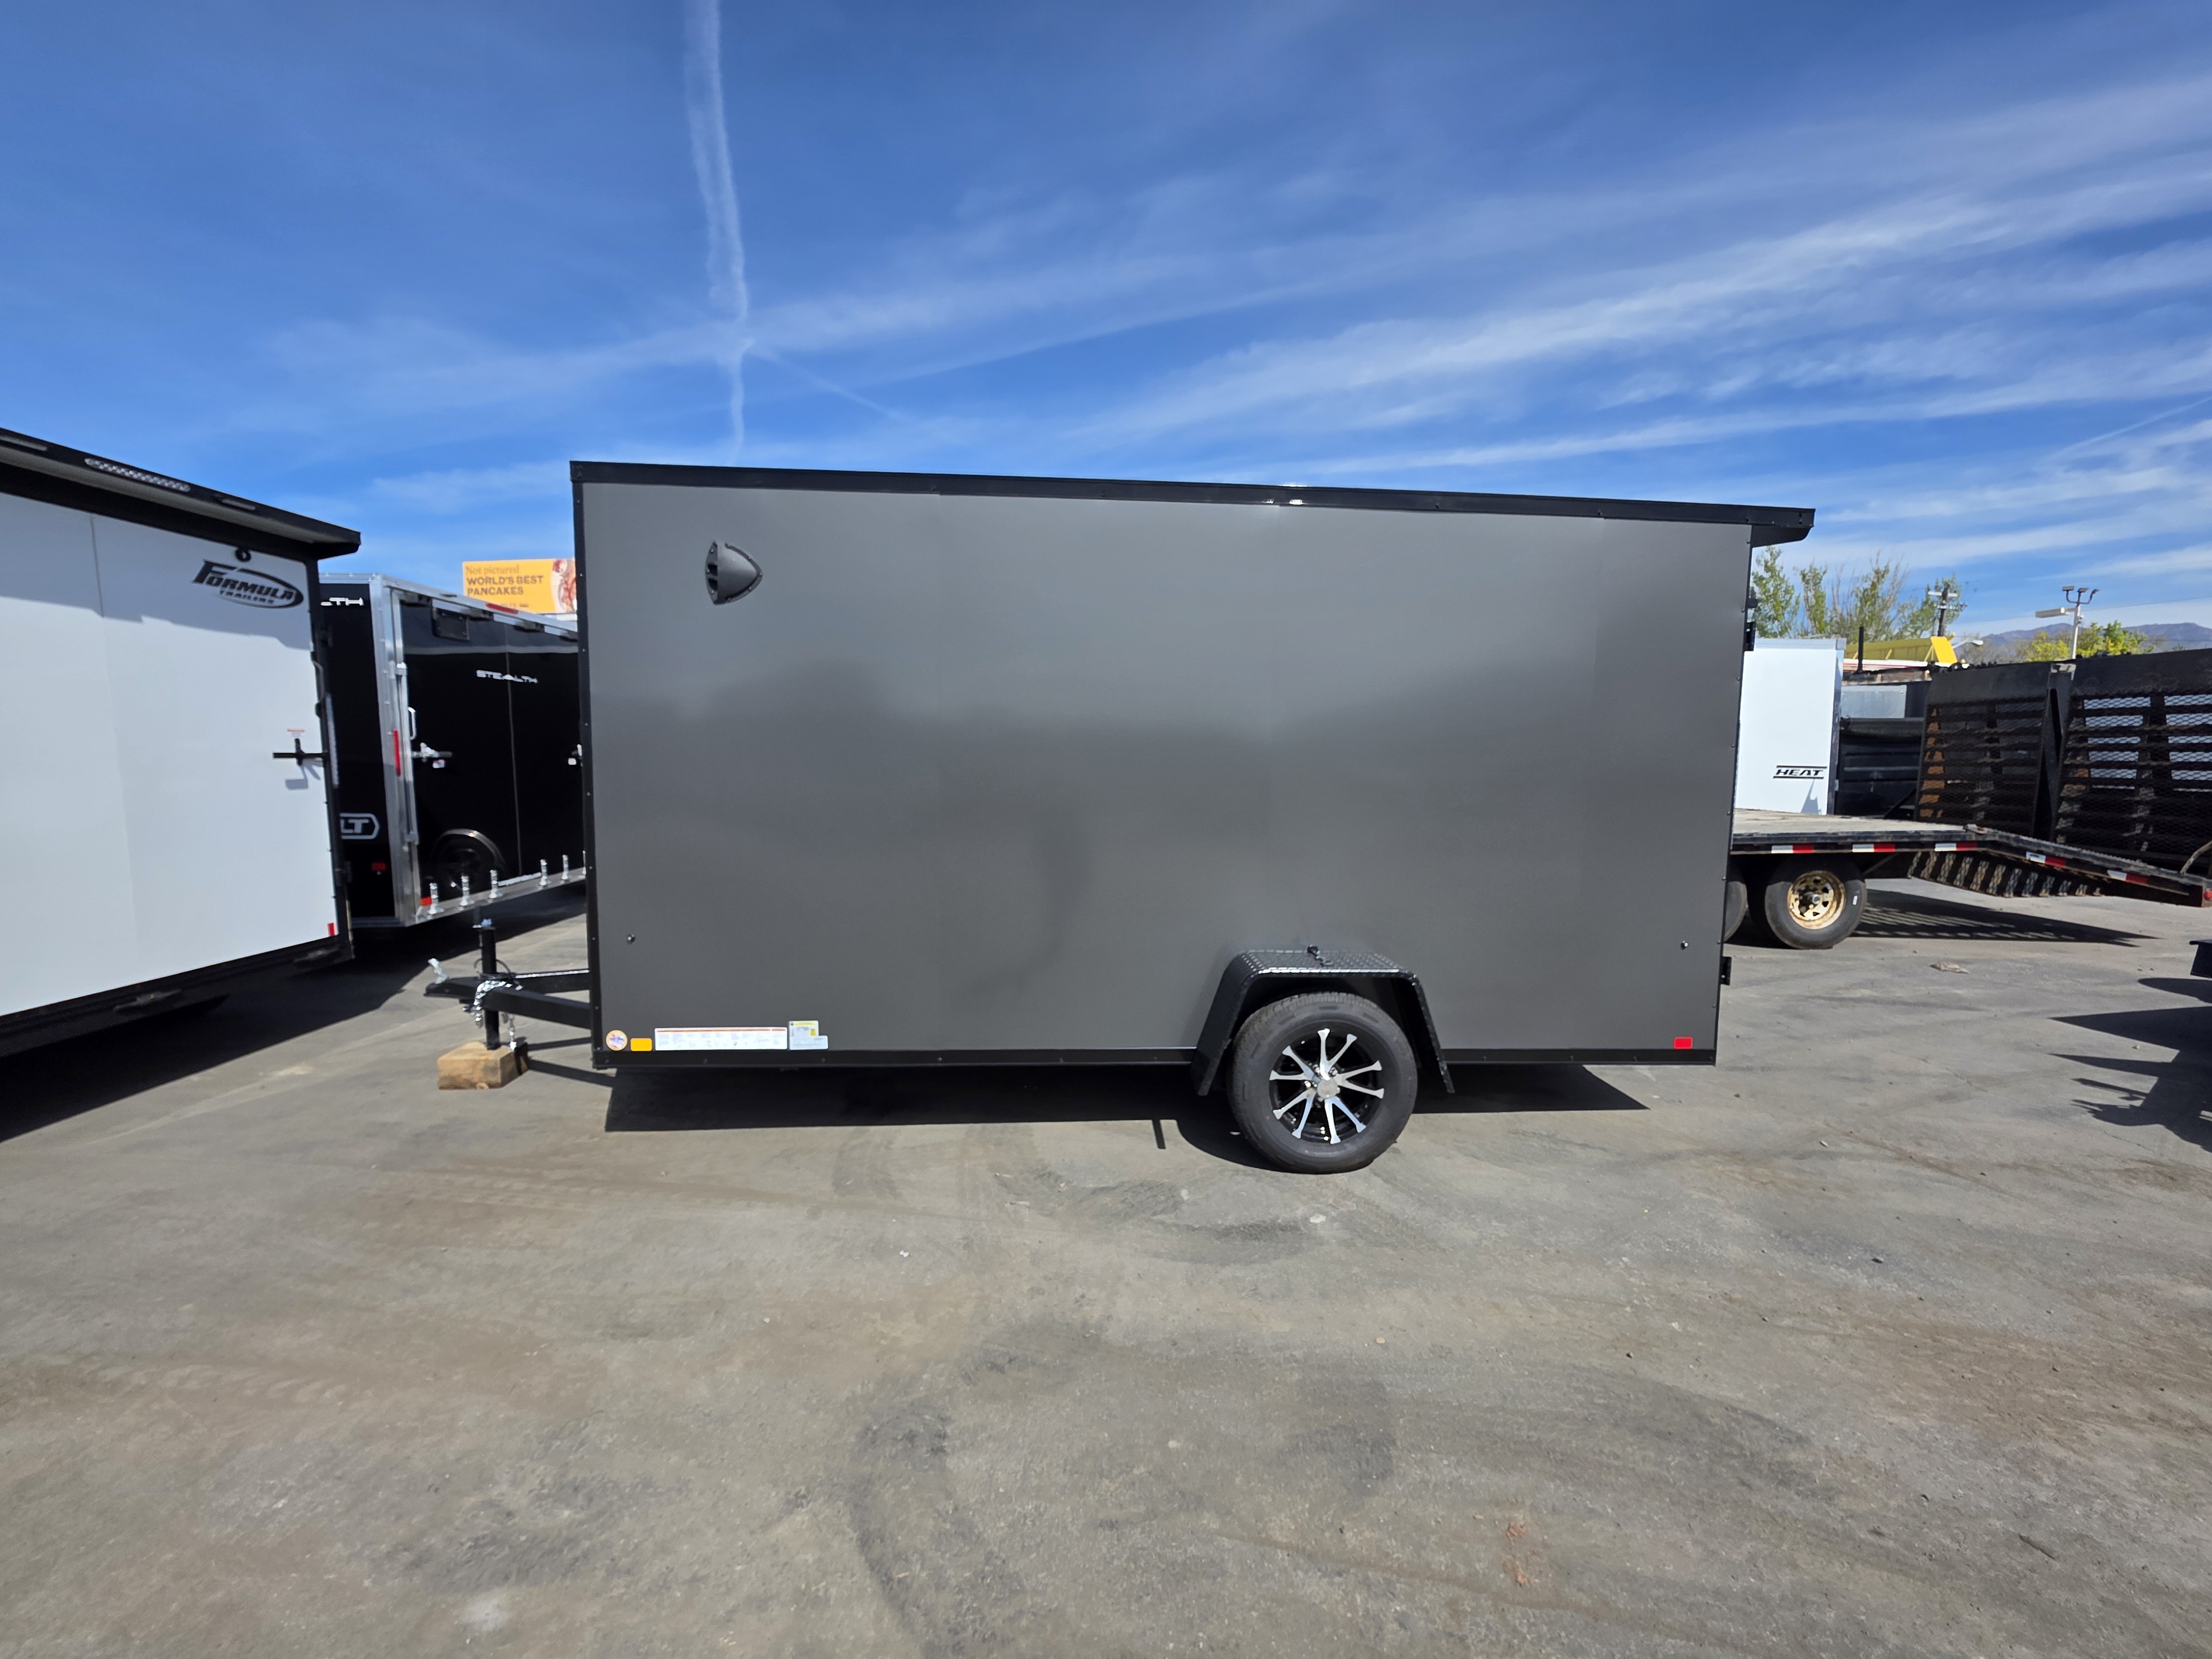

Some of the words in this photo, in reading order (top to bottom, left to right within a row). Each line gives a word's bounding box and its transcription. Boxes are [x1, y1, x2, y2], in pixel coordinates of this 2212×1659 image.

[466, 565, 482, 575] Not
[483, 563, 519, 576] pictured
[192, 559, 295, 601] FORMULA
[466, 576, 514, 586] WORLD'S
[516, 575, 544, 585] BEST
[467, 586, 524, 596] PANCAKES
[476, 669, 538, 685] STEALTH
